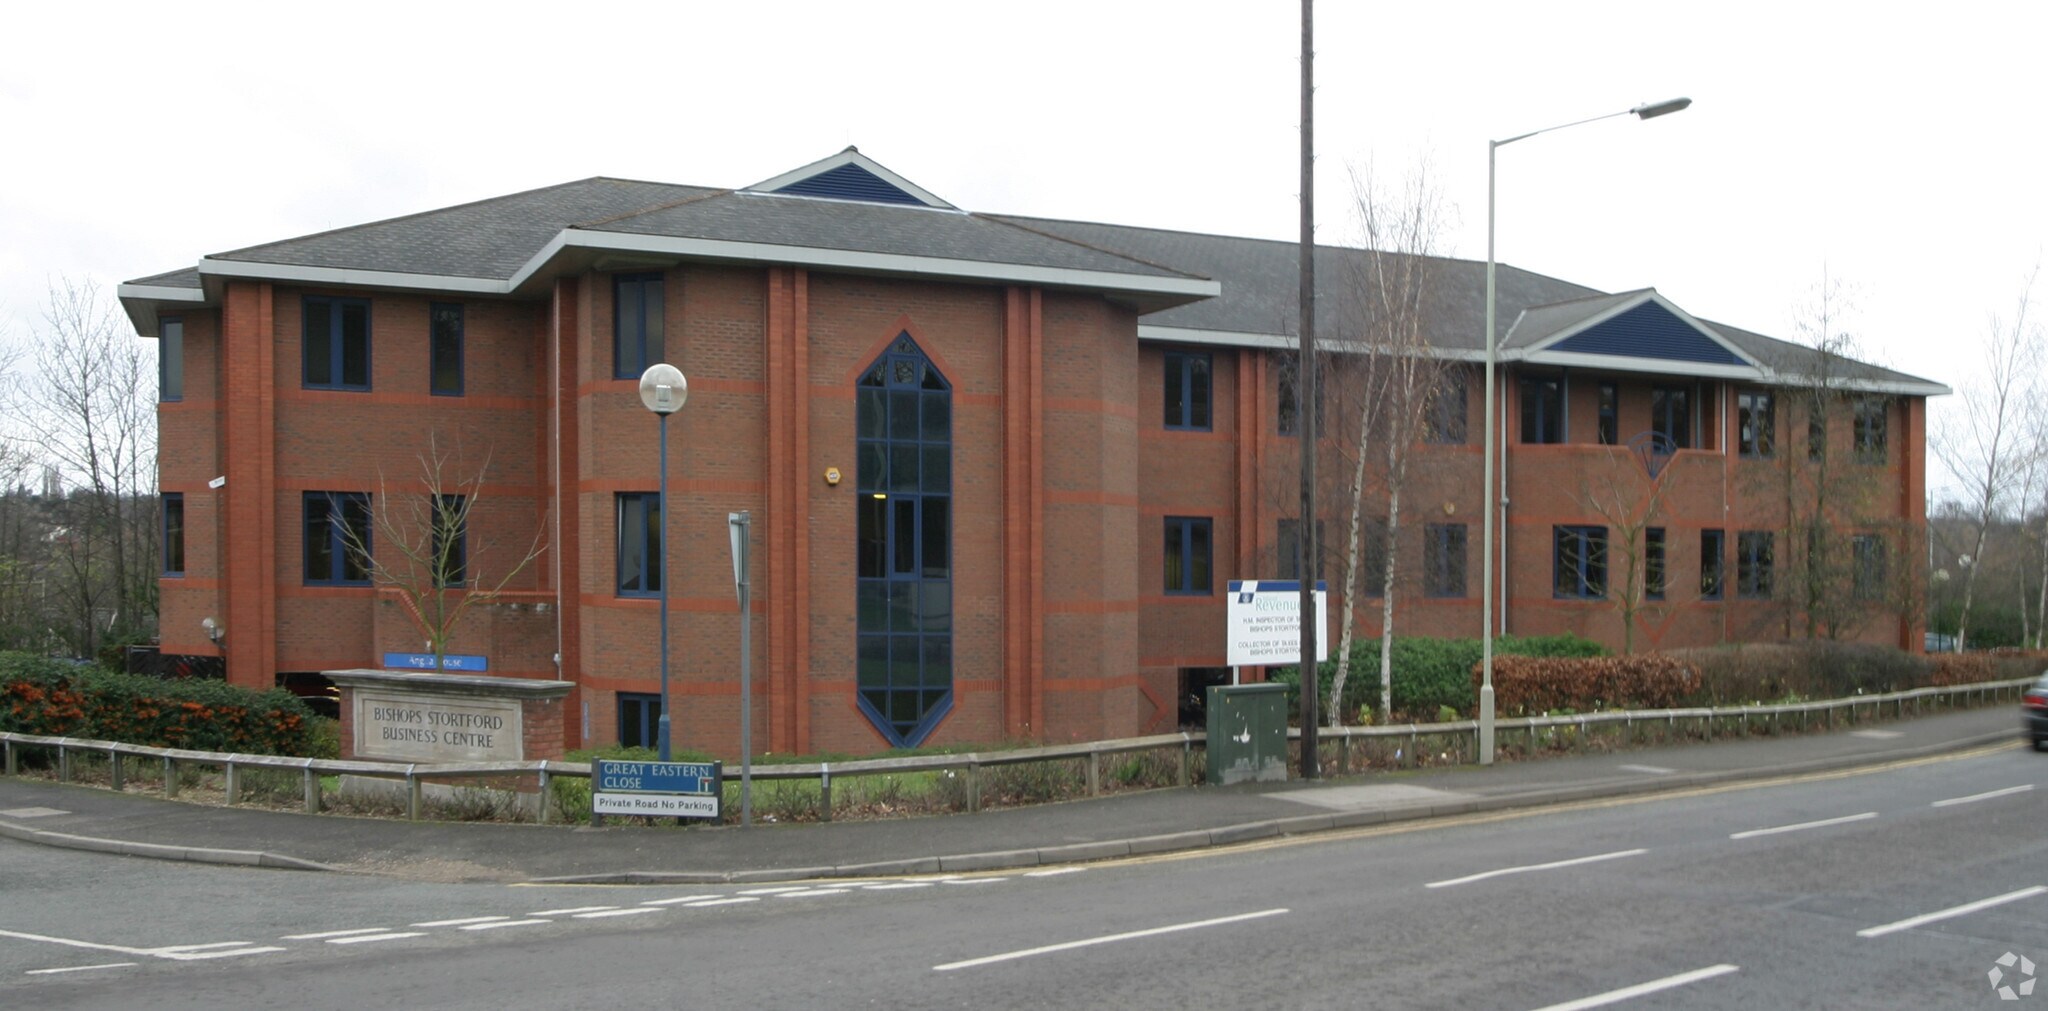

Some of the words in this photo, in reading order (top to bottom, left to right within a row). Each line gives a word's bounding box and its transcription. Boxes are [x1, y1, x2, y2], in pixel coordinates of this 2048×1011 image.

[1256, 616, 1286, 624] INSPECTOR
[1238, 640, 1270, 649] COLLECTOR
[374, 706, 422, 723] BISHOPS
[428, 711, 503, 730] STORTFORD
[383, 726, 437, 744] BUSINESS
[444, 731, 494, 748] CENTRE
[604, 764, 645, 775] GREAT
[652, 765, 709, 777] EASTERN
[604, 777, 642, 789] CLOSE
[599, 798, 632, 808] Private
[635, 799, 658, 809] Road
[661, 800, 675, 809] No
[678, 801, 713, 811] Parking
